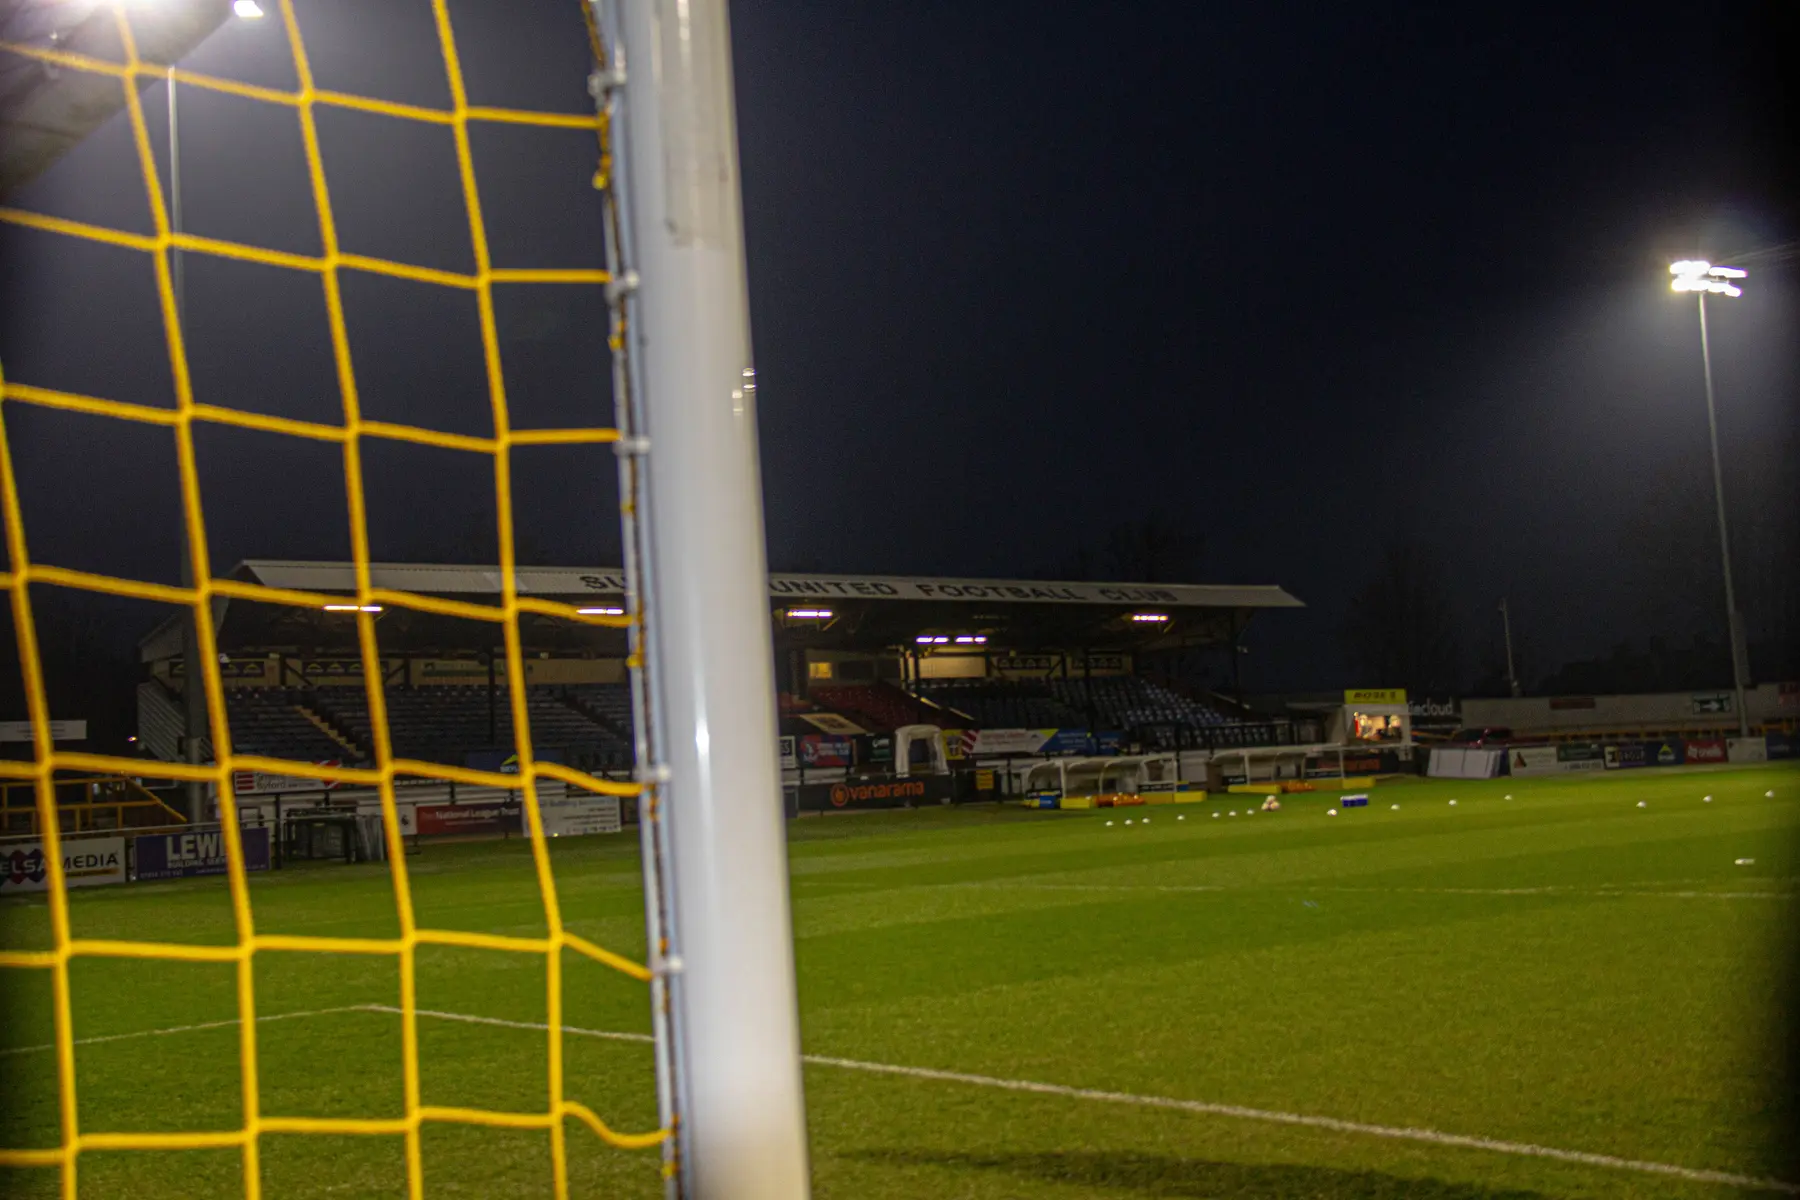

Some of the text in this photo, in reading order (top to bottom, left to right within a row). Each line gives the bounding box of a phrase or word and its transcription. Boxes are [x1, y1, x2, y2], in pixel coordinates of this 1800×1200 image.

[768, 580, 1178, 603] UNITED FOOTBALL CLUB
[849, 780, 925, 801] vanarama
[166, 832, 226, 861] LEWI
[62, 851, 119, 869] MEDIA
